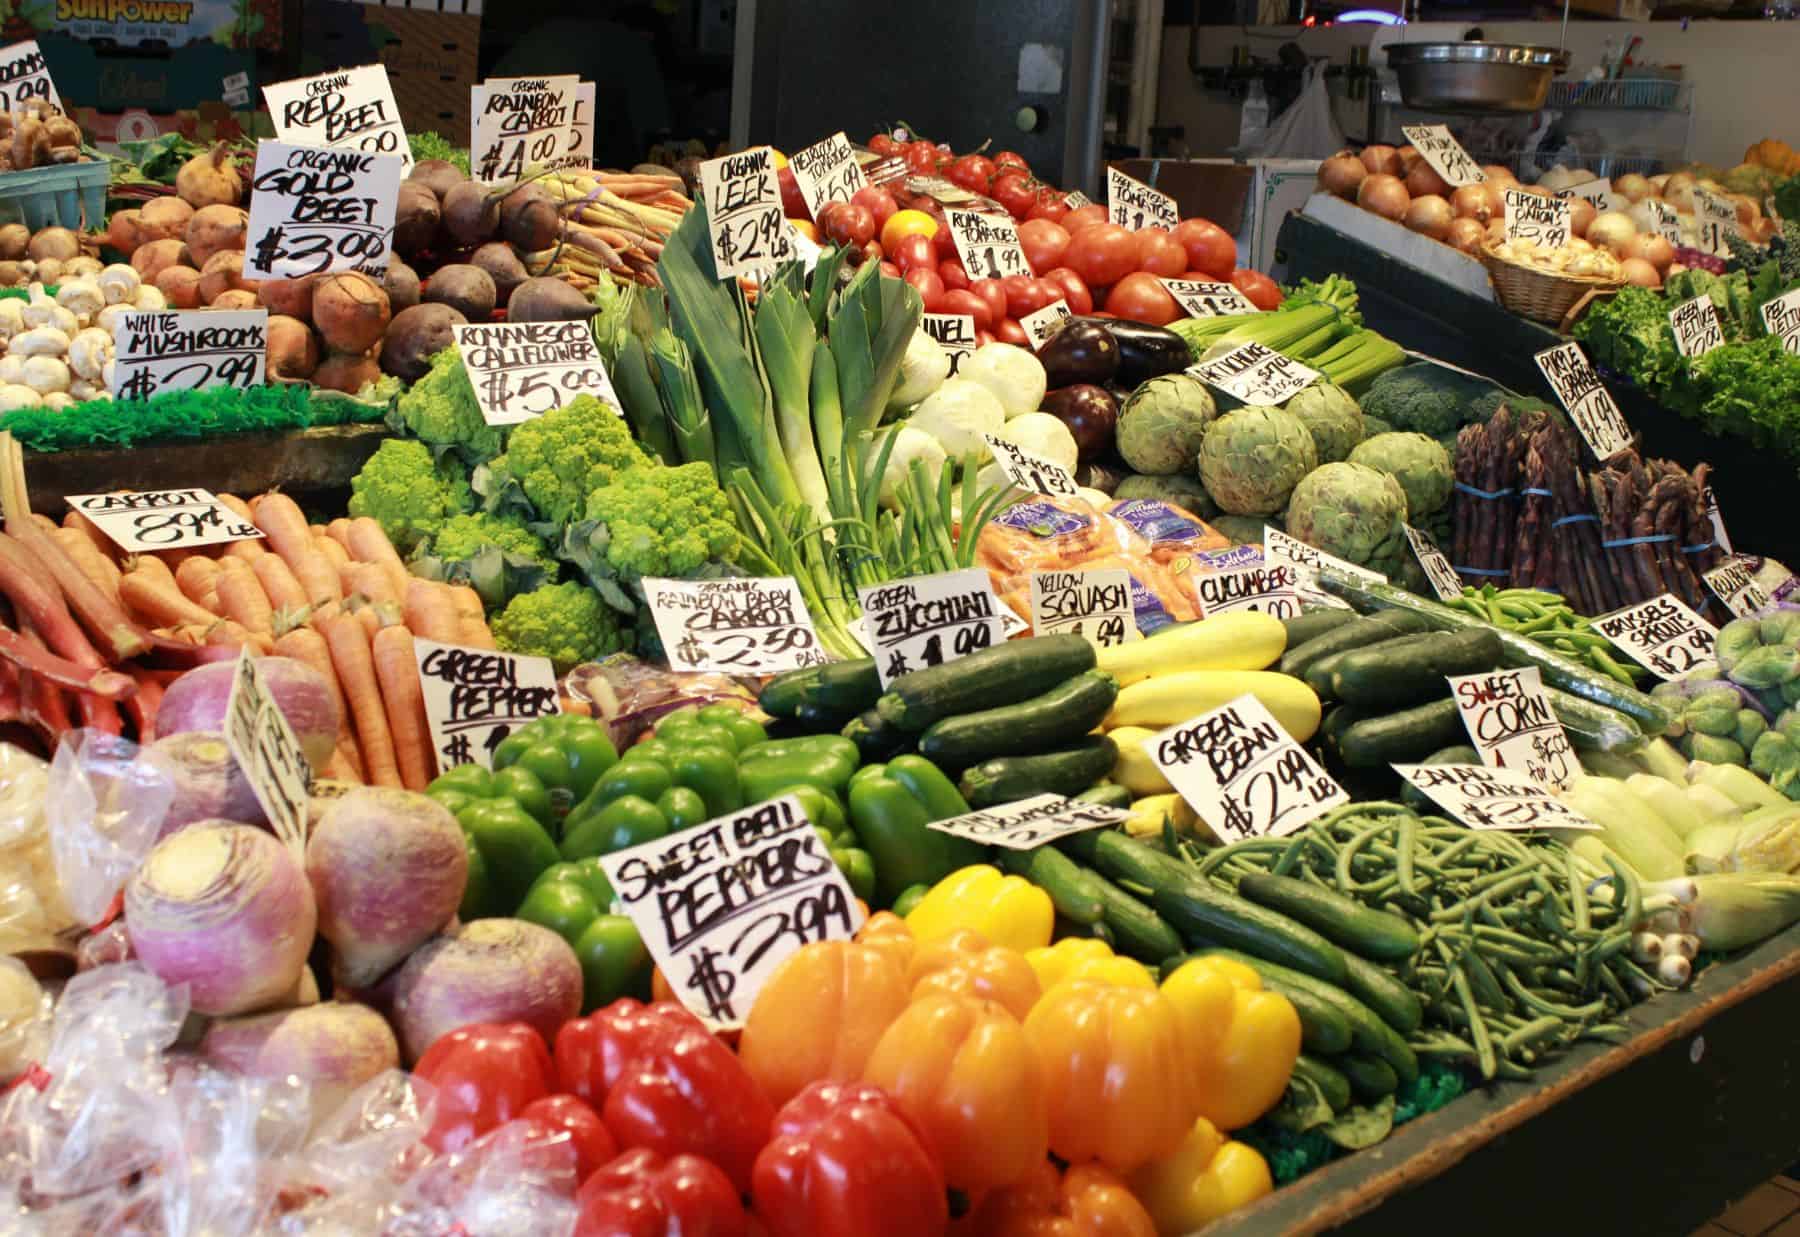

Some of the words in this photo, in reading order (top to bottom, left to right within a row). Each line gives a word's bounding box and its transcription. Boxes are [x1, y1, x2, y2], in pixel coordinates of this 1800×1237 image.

[284, 92, 345, 129] RED
[325, 100, 387, 142] BEET
[501, 107, 567, 131] CARROT
[287, 150, 375, 173] ORGANIC
[254, 168, 354, 196] GOLD
[714, 176, 776, 215] LEEK
[291, 196, 378, 224] BEET
[125, 313, 179, 333] WHITE
[128, 325, 265, 354] MUSHROOMS
[82, 491, 201, 509] CARROT
[866, 585, 917, 612] GREEN
[1037, 571, 1084, 594] YELLOW
[1200, 566, 1297, 604] CUCUMBER
[685, 607, 797, 631] CARROT
[874, 591, 993, 637] ZUCCHINI
[1040, 584, 1128, 620] SQUASH
[1601, 598, 1679, 638] BRUSSELS
[421, 649, 517, 687] GREEN
[1458, 672, 1524, 710] SWEET
[1159, 708, 1246, 766] GREEN
[1477, 696, 1550, 741] CORN
[1208, 722, 1280, 785] BEAN
[1308, 777, 1337, 804] LB
[617, 826, 730, 903] SWEET
[657, 836, 833, 949] PEPPERS
